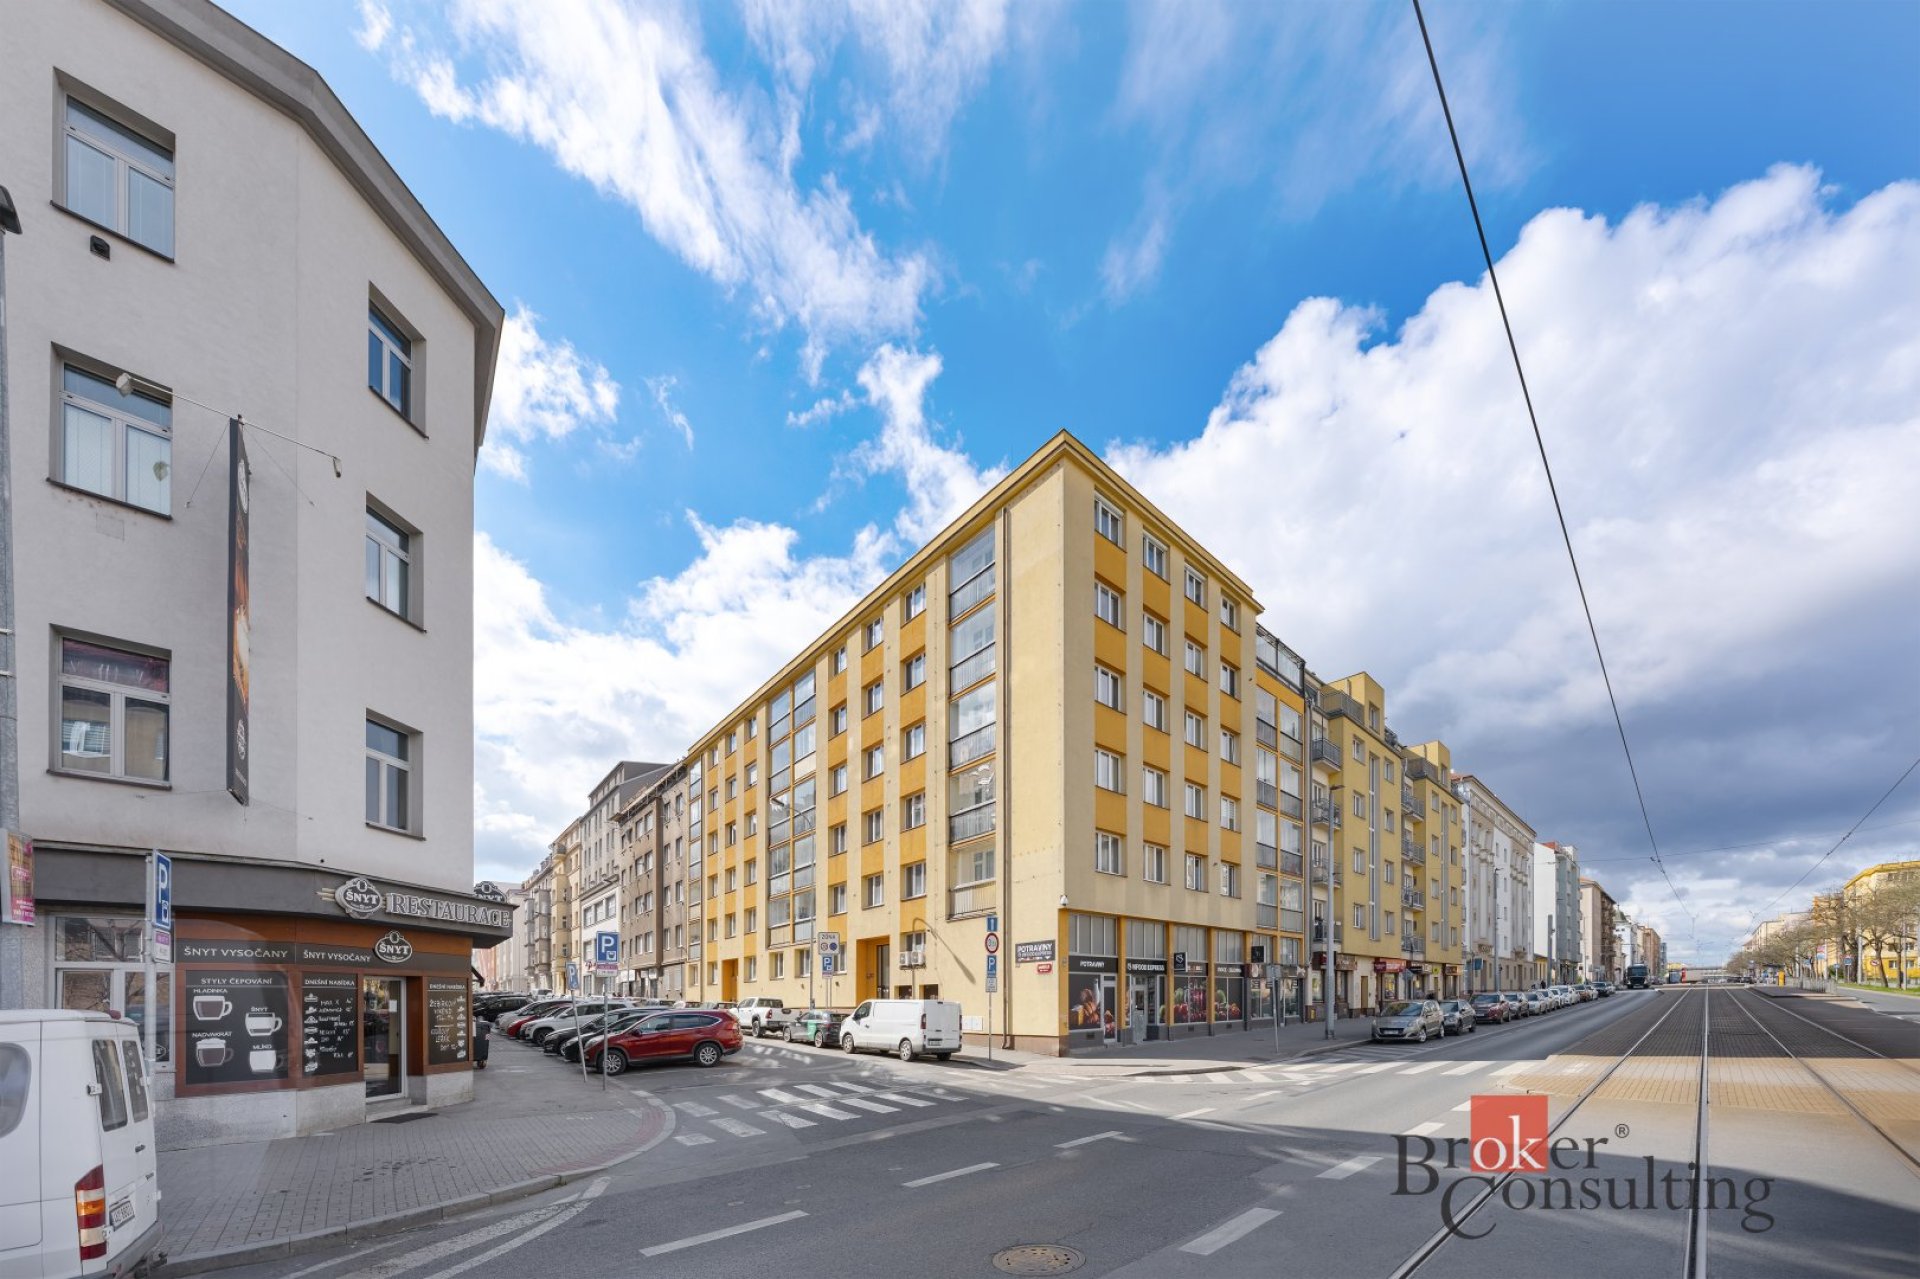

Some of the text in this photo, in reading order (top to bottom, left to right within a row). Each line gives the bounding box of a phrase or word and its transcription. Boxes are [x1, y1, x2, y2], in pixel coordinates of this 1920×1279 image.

[158, 862, 168, 903] P
[345, 888, 511, 928] ŠNYT RESTAURACE
[378, 941, 411, 956] ŠNYT
[602, 936, 615, 953] P
[184, 946, 289, 958] ŠNYT VYSOČANY
[303, 949, 326, 960] ŠNYT
[327, 951, 371, 963] VYSOČANY
[200, 976, 273, 985] STYLY ČEPOVÁNÍ
[304, 977, 355, 986] DNEŠNÍ NABÍDKA
